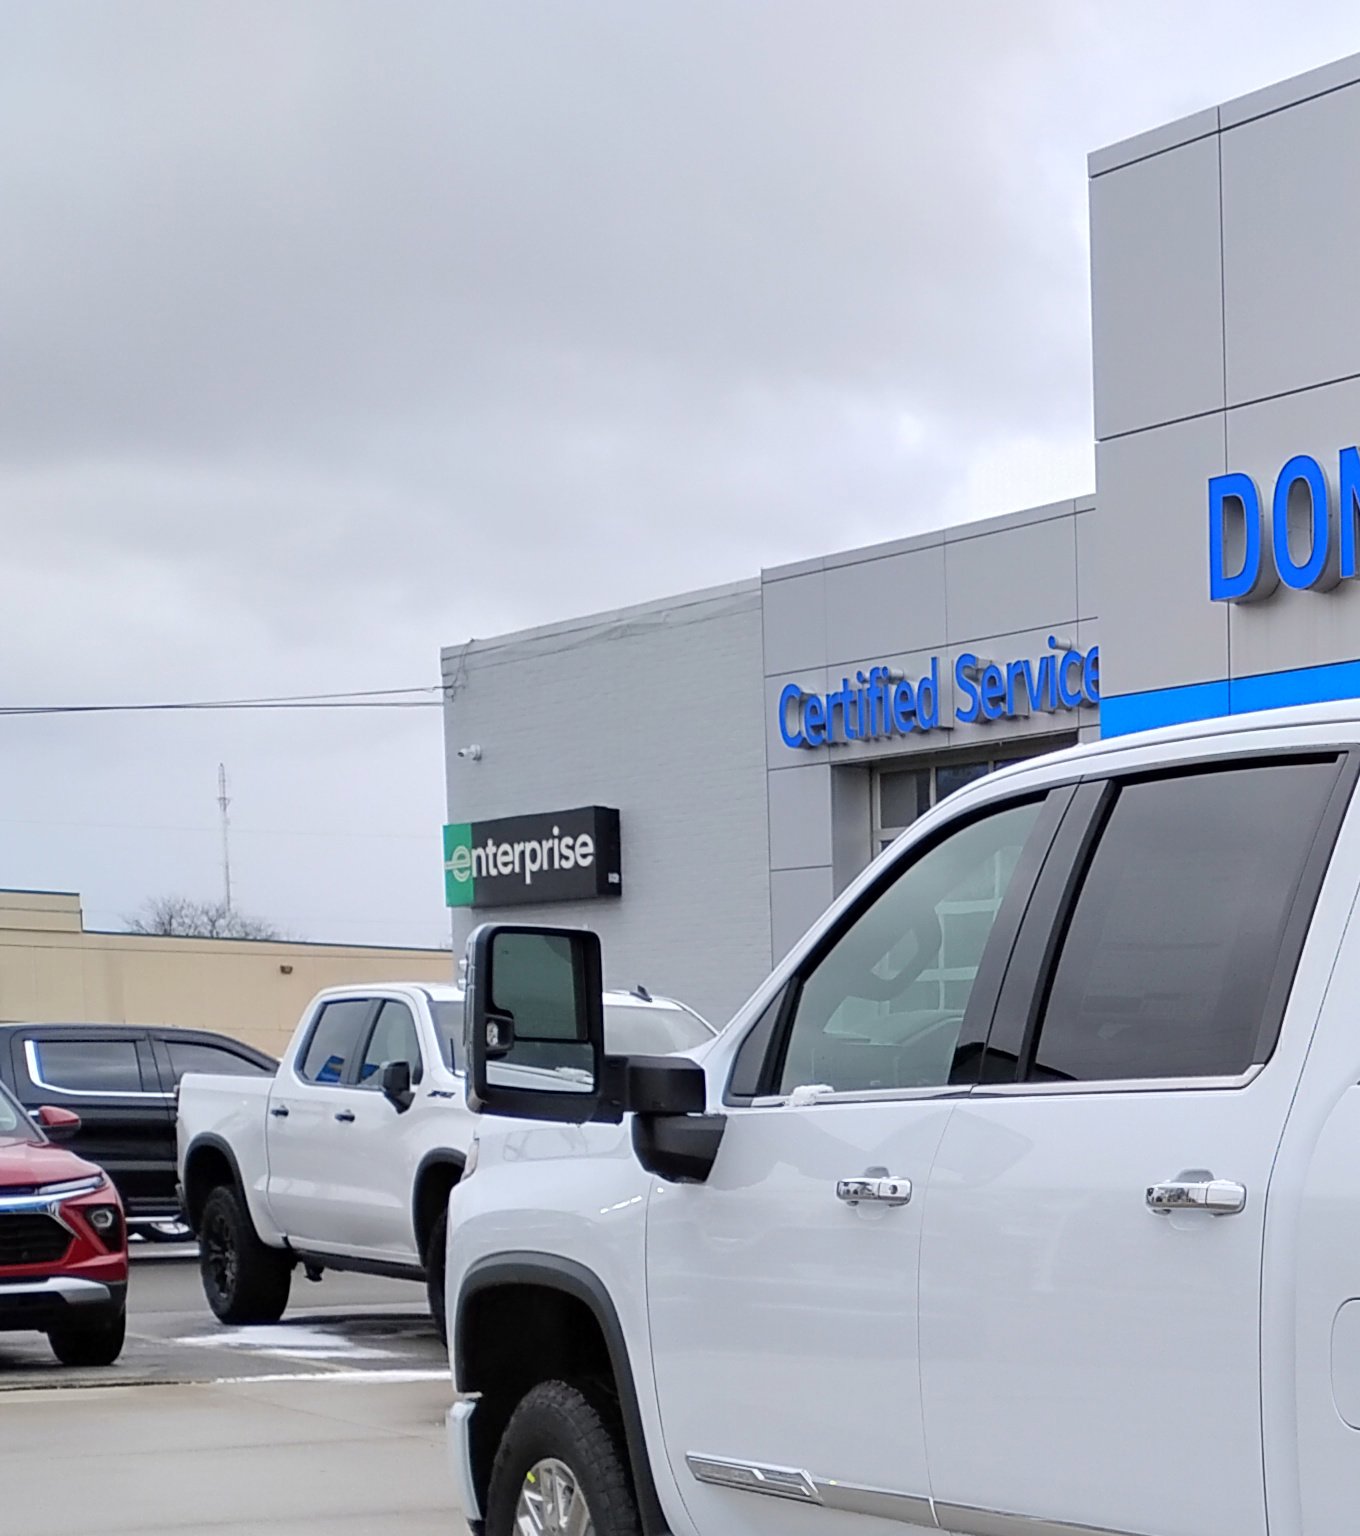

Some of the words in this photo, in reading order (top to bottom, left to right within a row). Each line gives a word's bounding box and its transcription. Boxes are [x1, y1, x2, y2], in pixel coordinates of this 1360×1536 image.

[778, 656, 948, 748] Certified
[955, 635, 1100, 723] Service
[445, 825, 595, 885] enterprise
